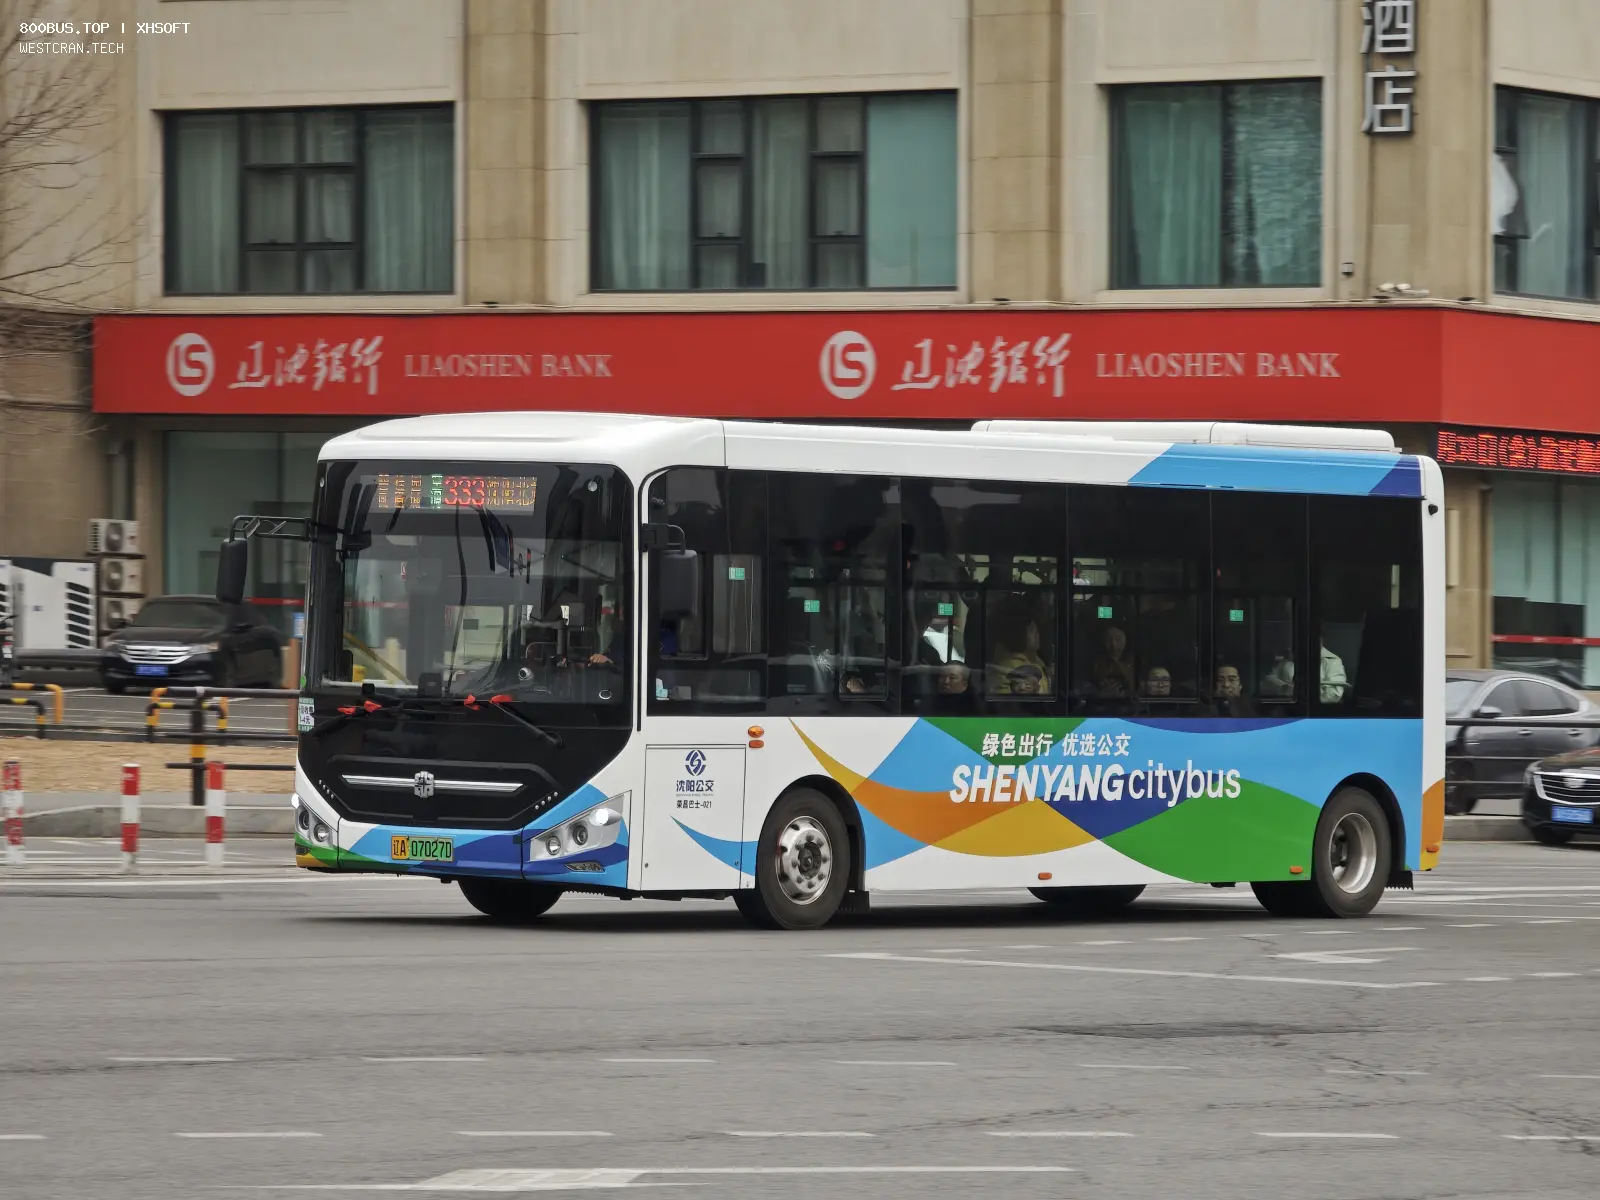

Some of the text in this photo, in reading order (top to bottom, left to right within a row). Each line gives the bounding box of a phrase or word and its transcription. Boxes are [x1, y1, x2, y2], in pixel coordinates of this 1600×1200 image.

[1360, 0, 1416, 133] 酒店
[404, 354, 613, 377] LIAOSHEN BANK
[1096, 352, 1341, 378] LIAOSHEN BANK
[444, 476, 486, 507] 333
[981, 733, 1132, 757] 绿色出行 优选公交
[676, 780, 714, 792] 沈阳公交
[949, 760, 1241, 807] SHENYANG citybus
